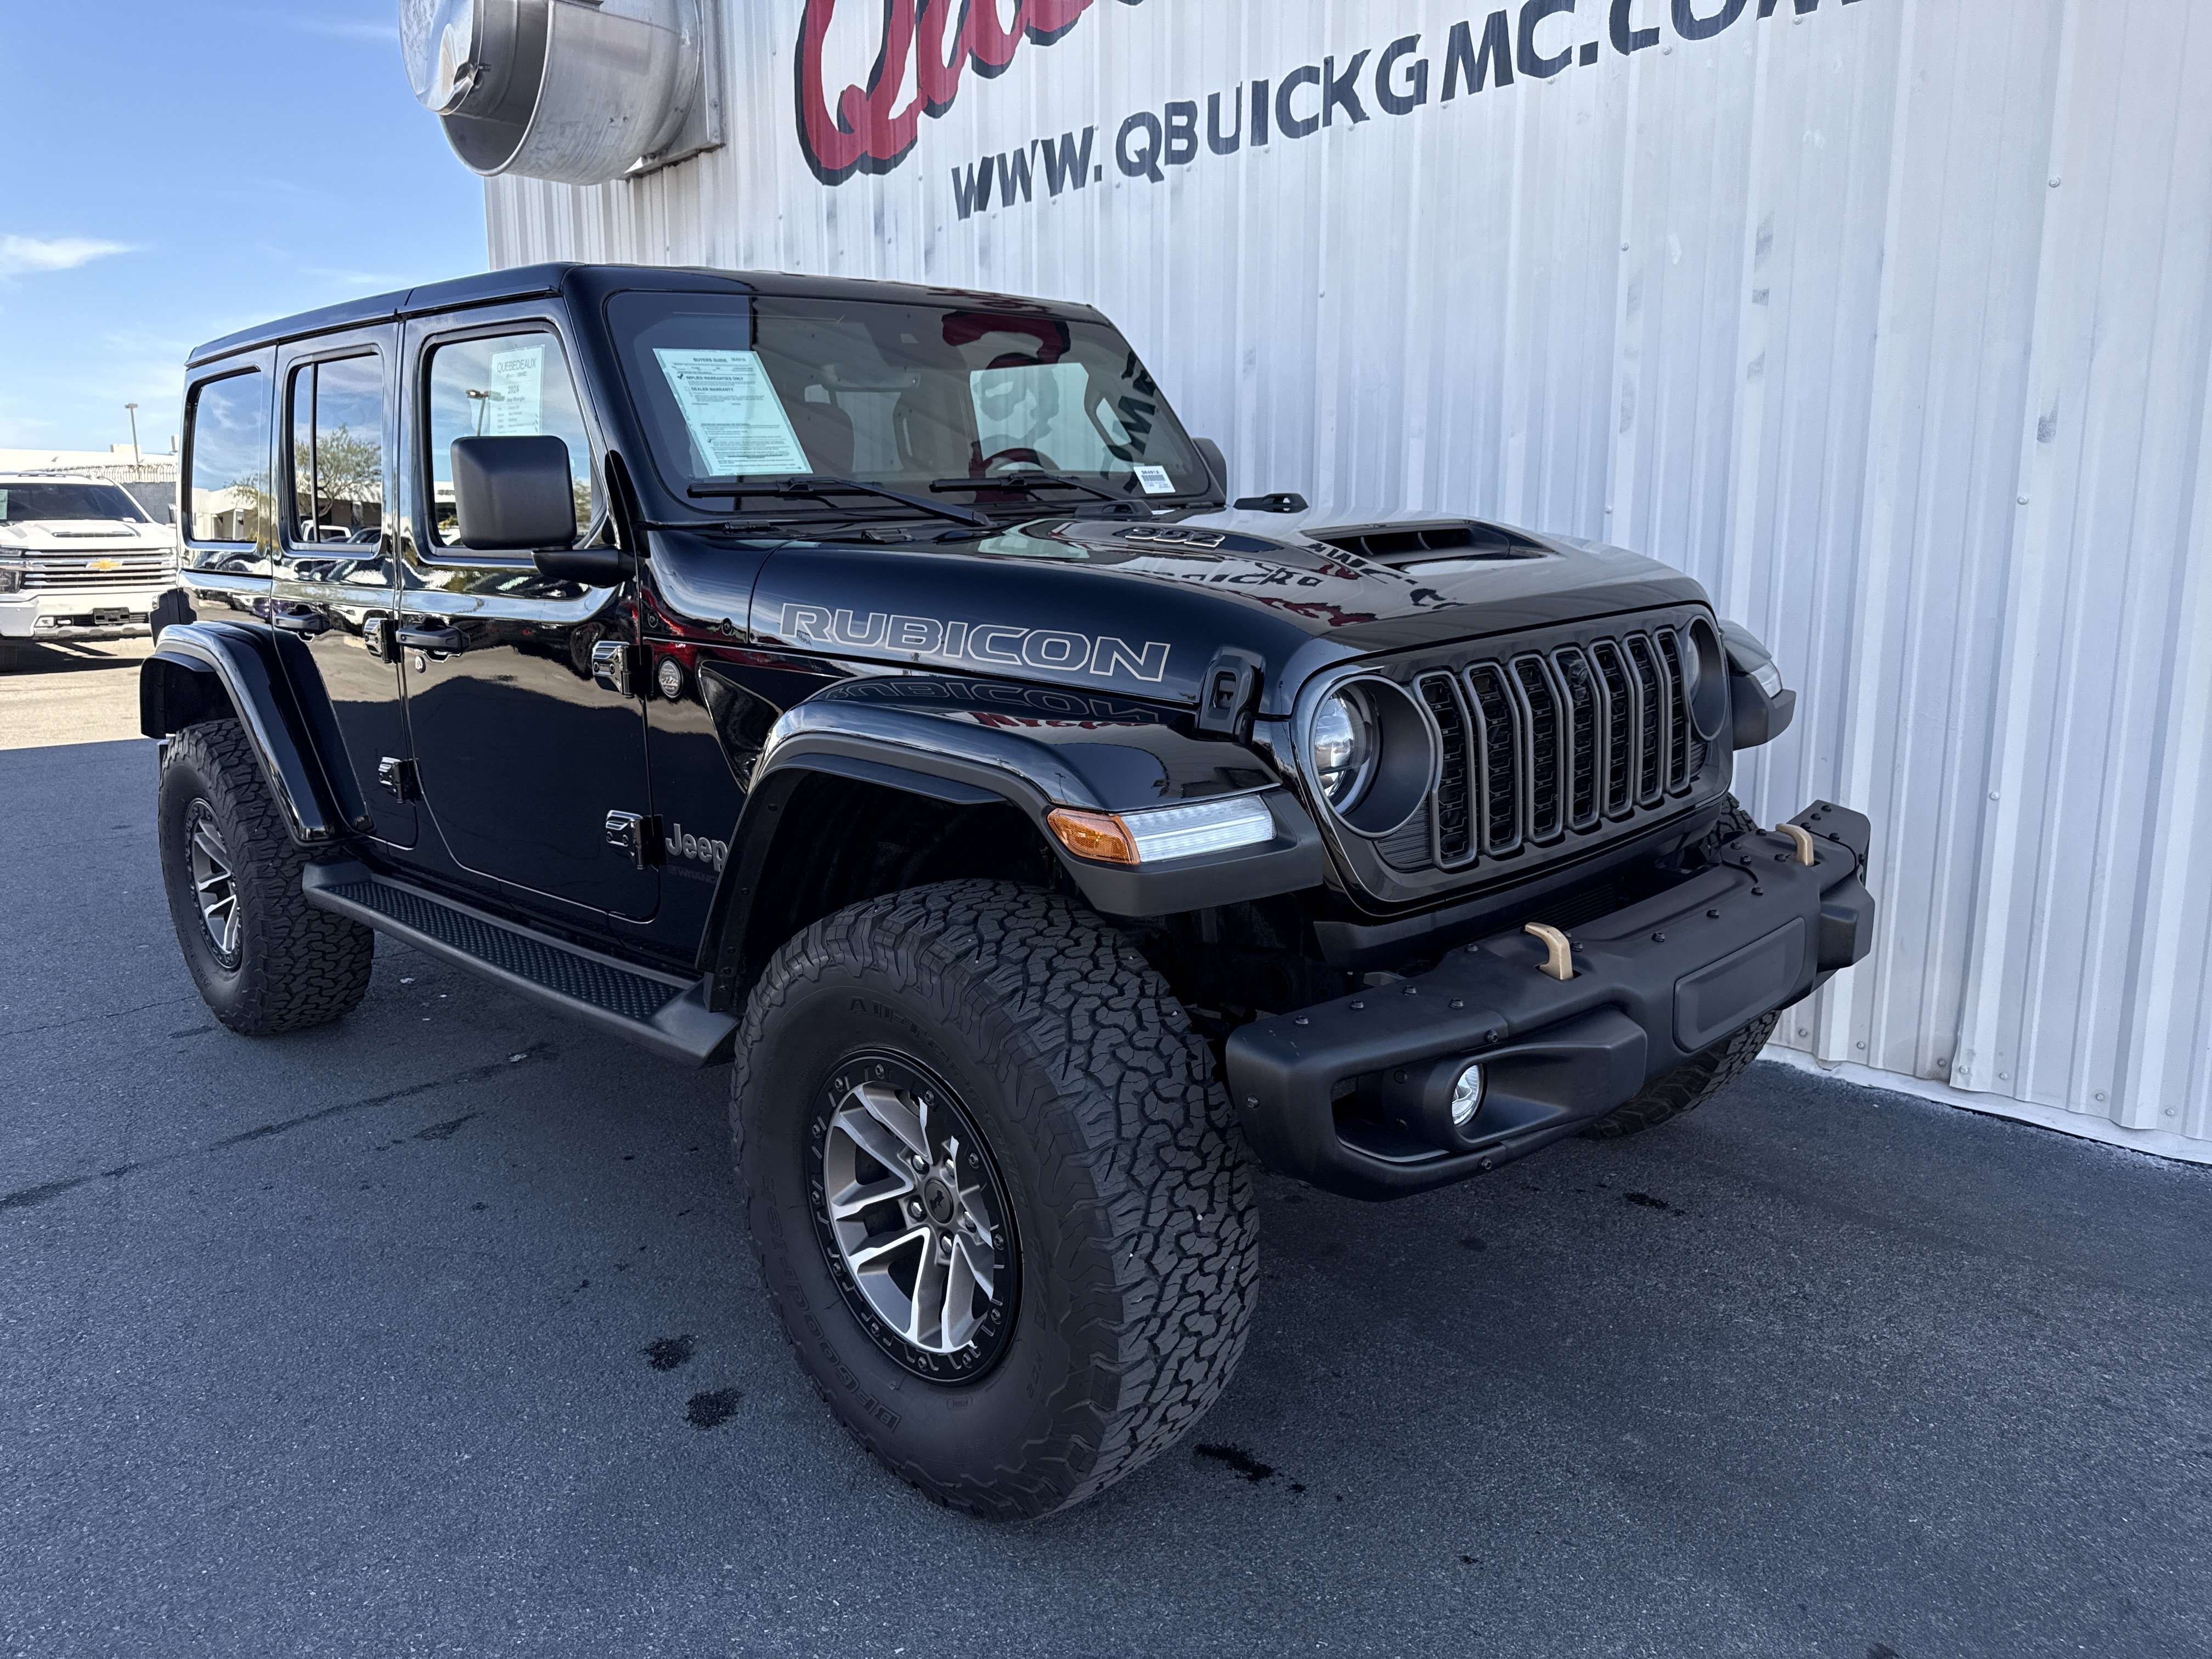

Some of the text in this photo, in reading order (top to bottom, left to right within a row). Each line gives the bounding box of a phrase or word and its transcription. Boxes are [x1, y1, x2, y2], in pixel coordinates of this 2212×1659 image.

[496, 358, 537, 374] QUEBEDEAUX
[508, 385, 520, 394] 2024
[779, 602, 1171, 682] RUBICON
[665, 823, 729, 872] Jeep
[760, 1172, 902, 1433] BFGoodrich
